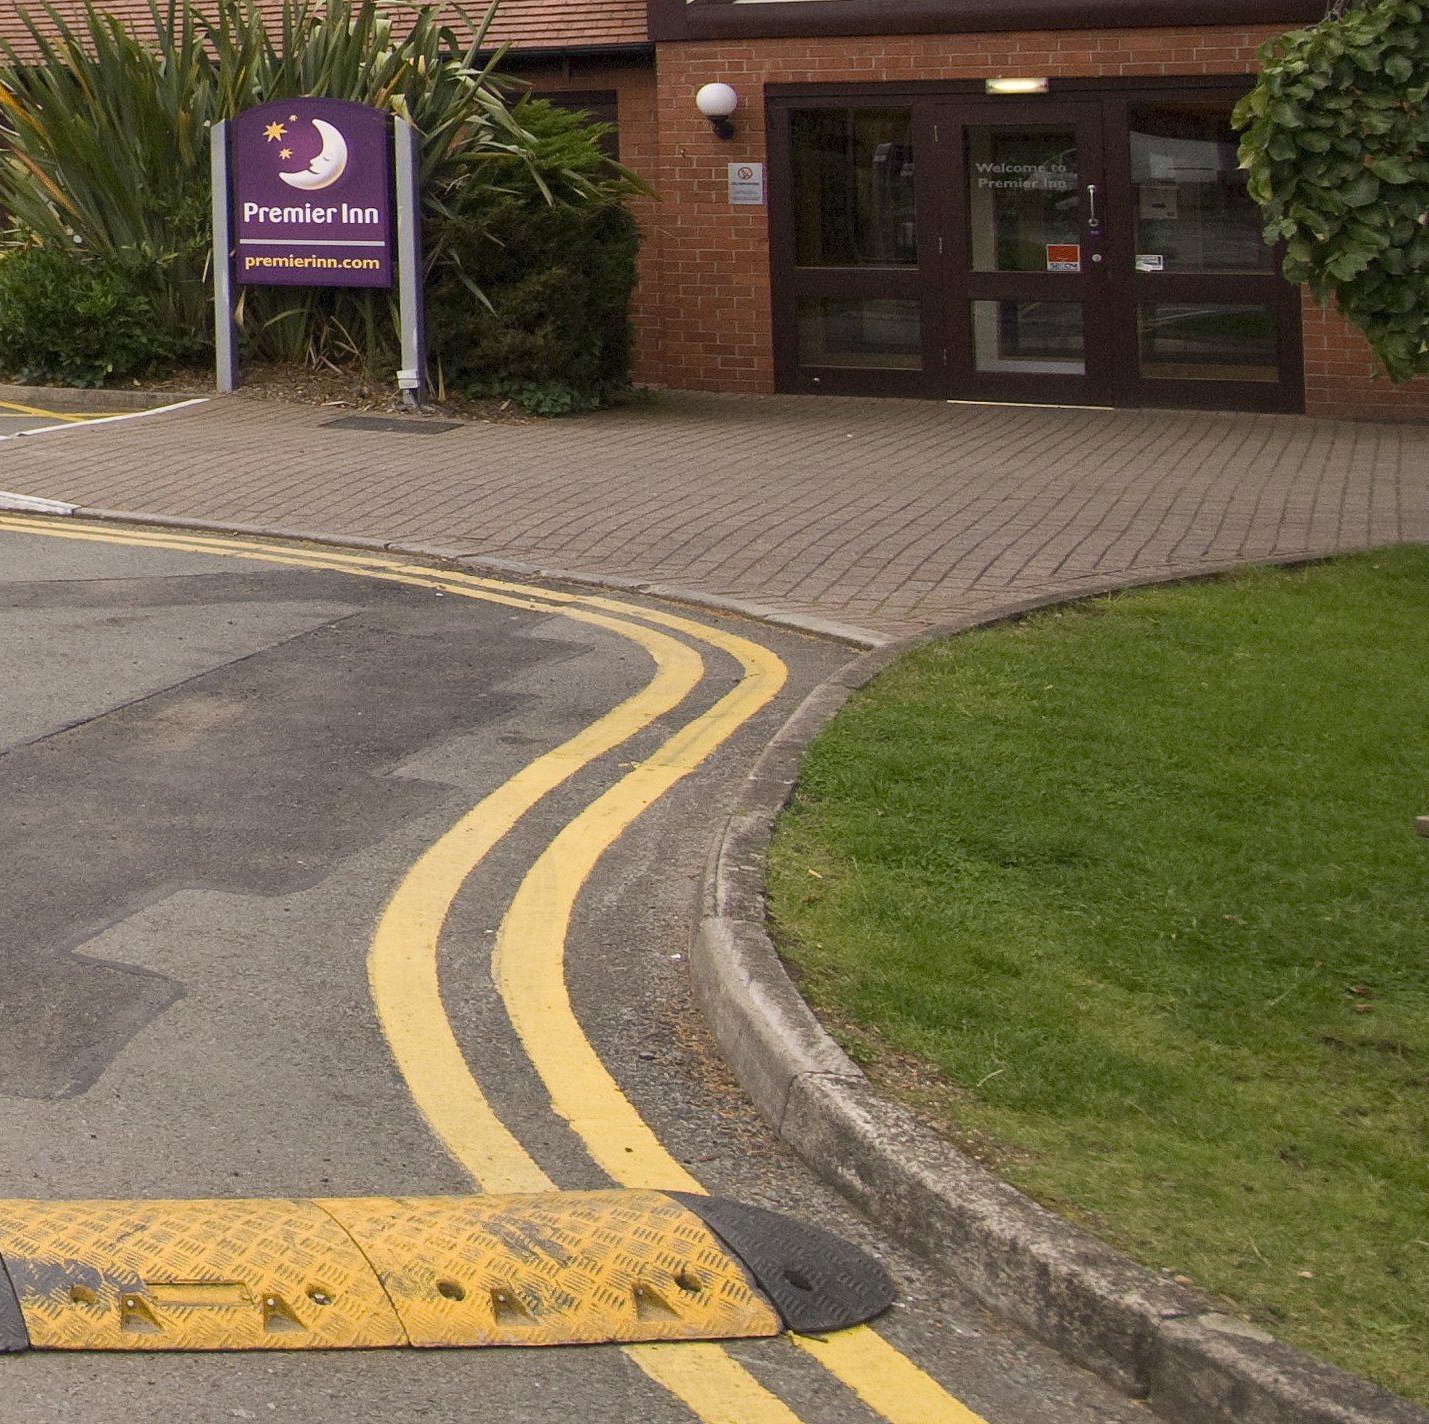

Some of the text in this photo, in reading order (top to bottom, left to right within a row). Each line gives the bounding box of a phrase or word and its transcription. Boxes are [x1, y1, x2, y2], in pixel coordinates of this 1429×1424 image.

[976, 163, 1066, 173] Welcome to
[979, 178, 1038, 188] Premier
[243, 202, 379, 224] Premier Inn
[245, 254, 380, 270] premierinn.com
